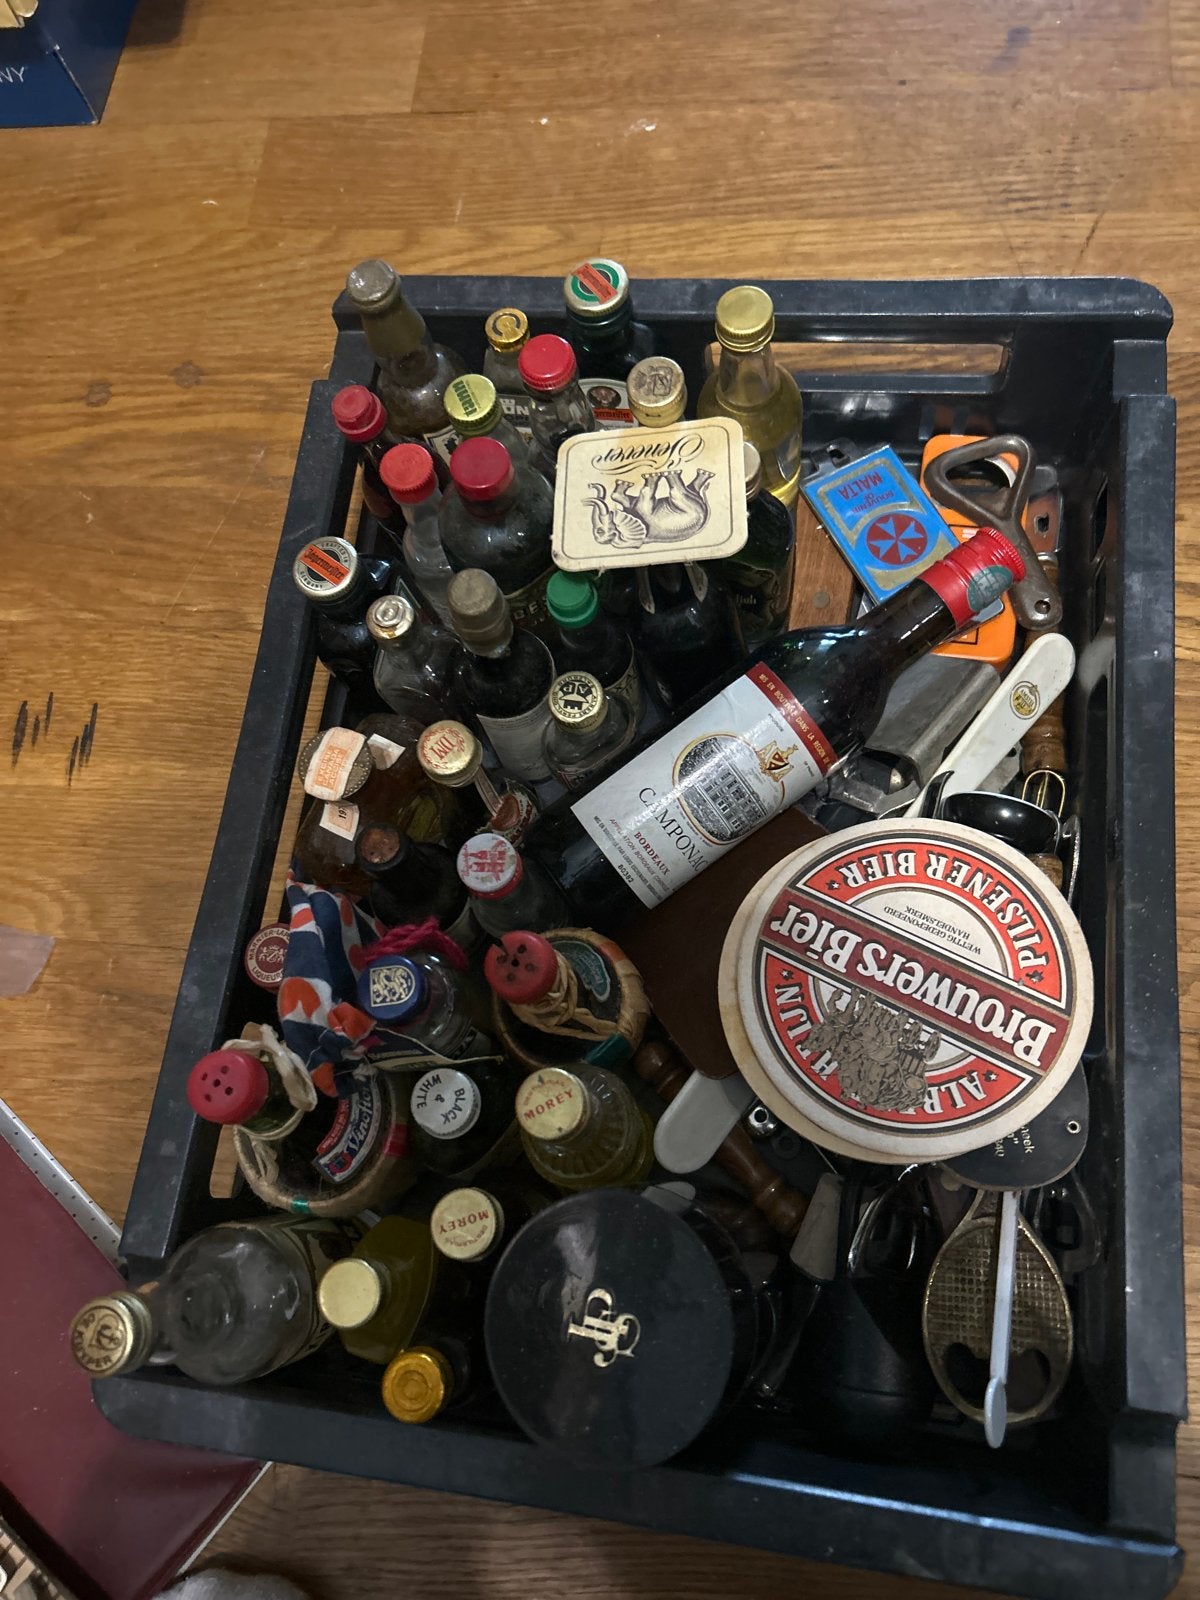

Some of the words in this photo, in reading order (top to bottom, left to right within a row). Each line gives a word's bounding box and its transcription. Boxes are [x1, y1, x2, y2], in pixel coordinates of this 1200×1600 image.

[837, 471, 883, 501] MALTA
[320, 746, 340, 787] CANADA
[633, 831, 671, 877] BORDEAUX
[837, 850, 918, 889] BIER
[883, 905, 945, 938] GEDEPONEERD
[904, 905, 971, 940] HANDELSMERK
[926, 851, 1049, 970] PILSENER
[945, 930, 981, 955] WETTIG
[416, 1074, 442, 1109] WHITE
[435, 1094, 445, 1103] &
[442, 1088, 465, 1124] BLACK
[522, 1088, 574, 1122] MOREY
[439, 1208, 490, 1236] MOREY
